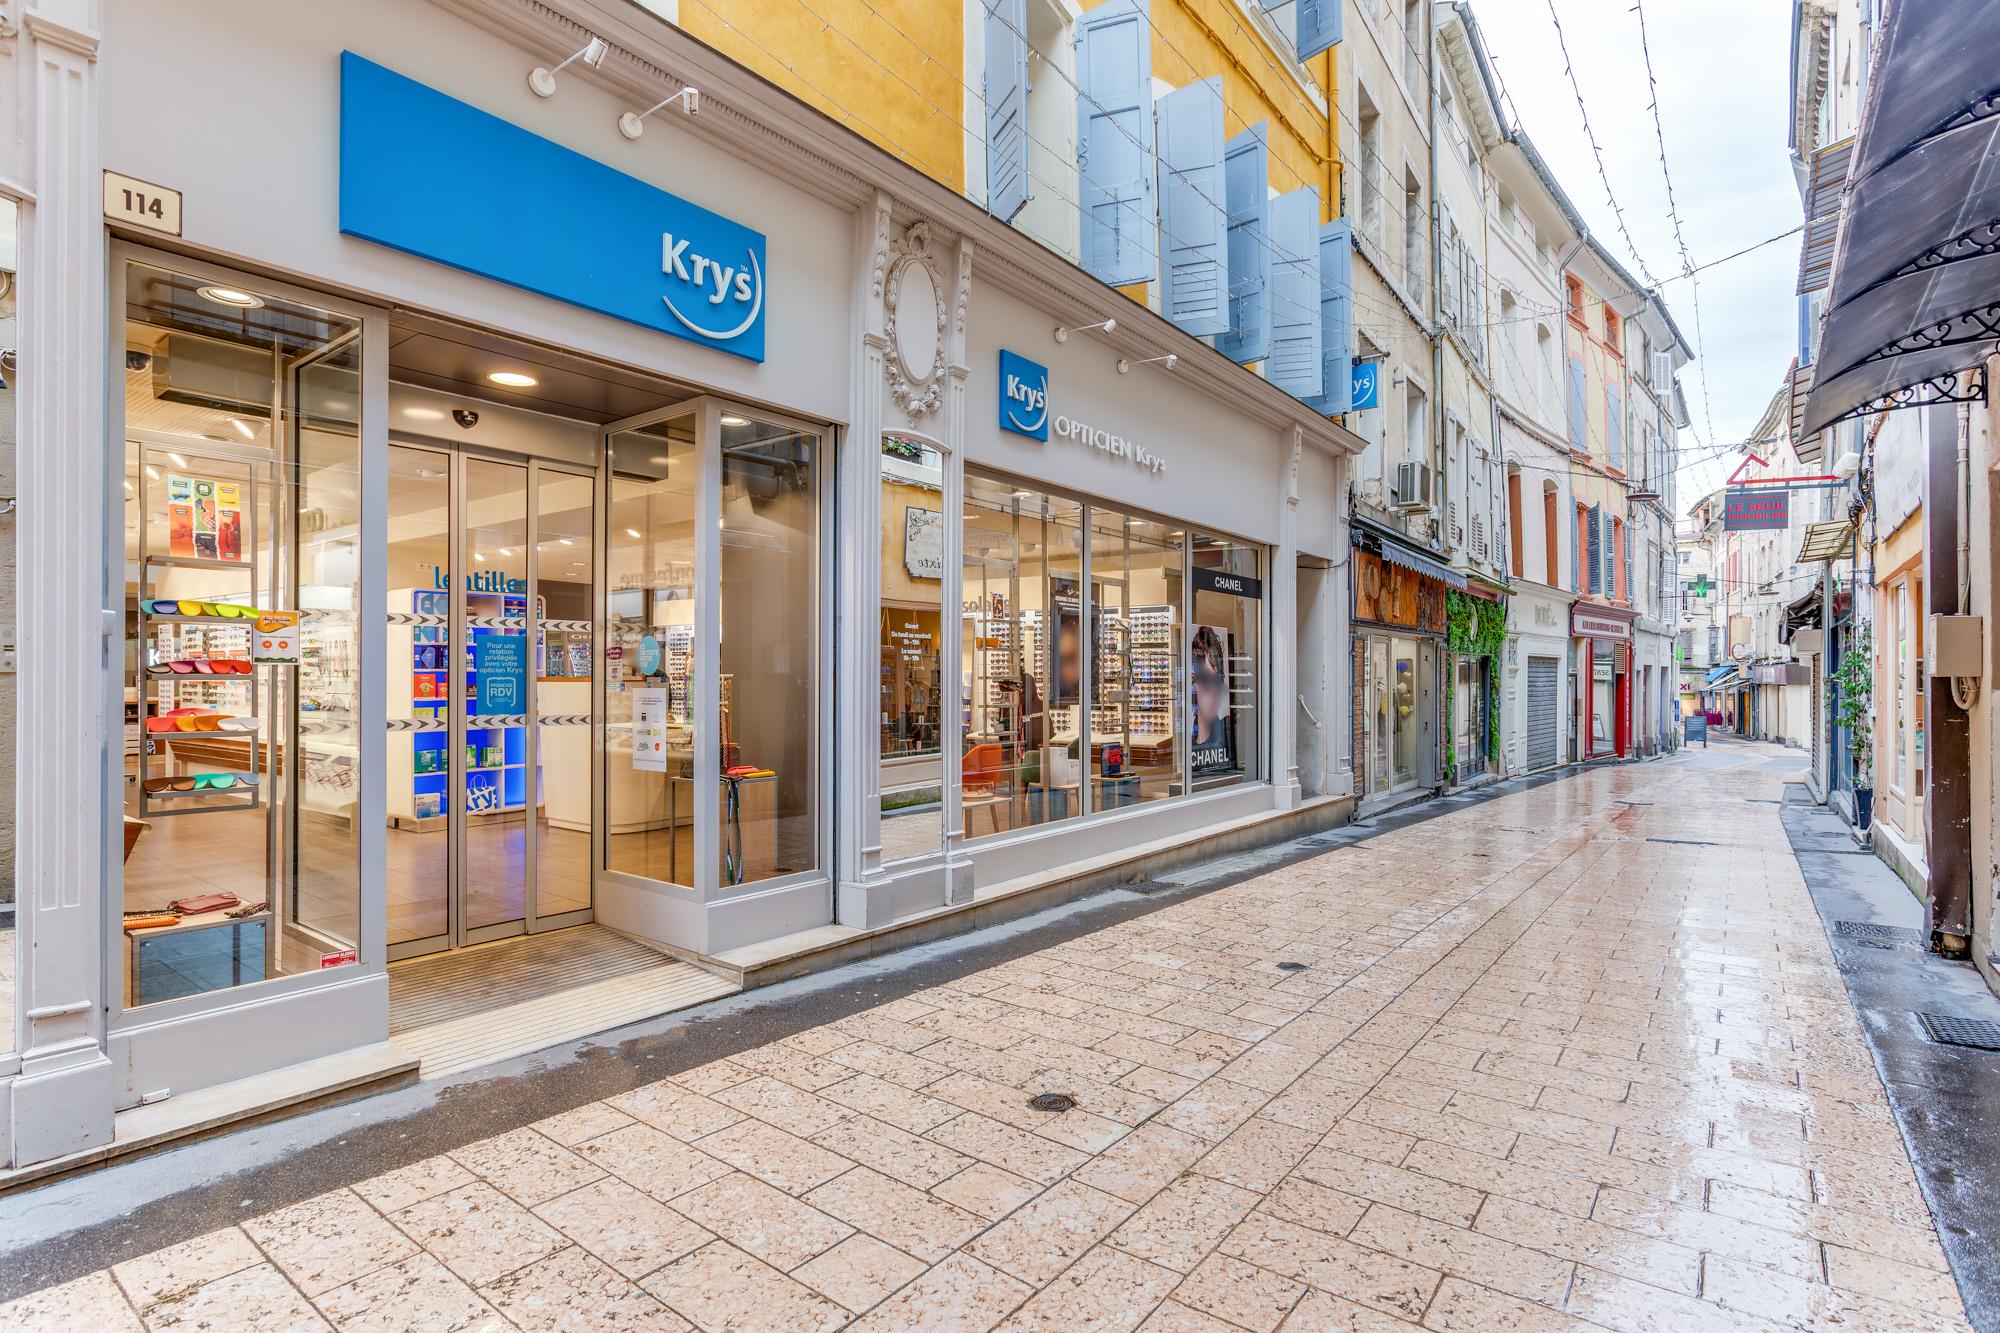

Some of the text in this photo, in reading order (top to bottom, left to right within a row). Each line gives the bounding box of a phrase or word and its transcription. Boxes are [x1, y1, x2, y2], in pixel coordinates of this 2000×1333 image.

[122, 188, 164, 220] 114
[662, 232, 752, 304] Krys
[1007, 374, 1044, 411] Krys
[1054, 415, 1167, 473] OPTICIEN Krys
[1727, 500, 1787, 512] LE SEUIL
[1214, 576, 1243, 592] CHANEL
[507, 666, 523, 674] Krys
[490, 688, 513, 697] RDV
[1190, 747, 1230, 767] CHANEL
